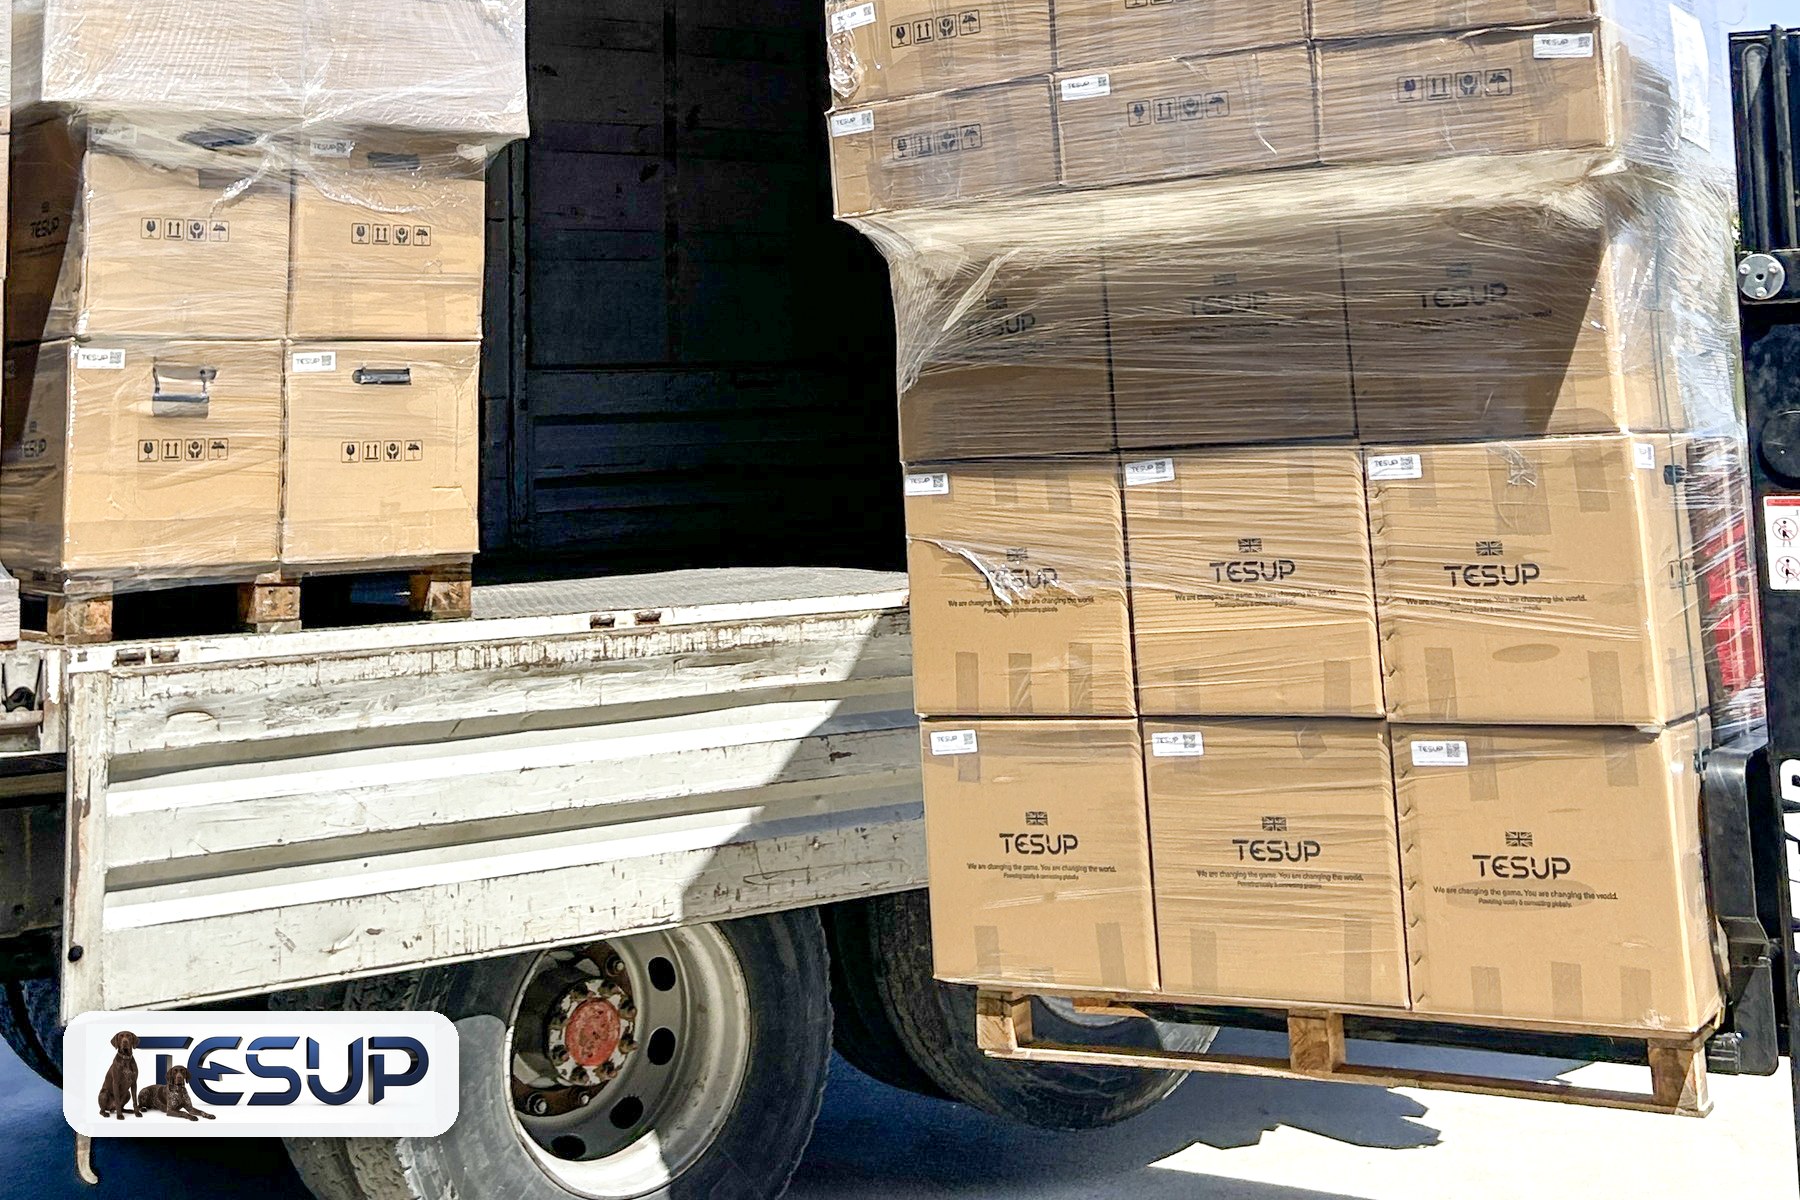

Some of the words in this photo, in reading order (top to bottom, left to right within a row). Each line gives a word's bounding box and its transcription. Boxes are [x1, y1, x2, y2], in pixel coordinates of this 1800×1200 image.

[81, 353, 109, 362] TESUP
[295, 357, 321, 366] TESUP
[1131, 464, 1154, 474] TESUP
[1373, 459, 1399, 468] TESUP
[909, 477, 931, 485] TESUP
[1209, 559, 1296, 583] TESUP
[1443, 563, 1540, 588] TESUP
[1406, 598, 1419, 606] We
[1521, 595, 1551, 604] changing
[936, 734, 958, 743] TESUP
[1155, 736, 1179, 745] TESUP
[1417, 745, 1444, 753] TESUP
[998, 832, 1078, 855] TESUP
[1232, 838, 1321, 863] TESUP
[966, 862, 977, 870] We
[987, 862, 1012, 871] changing
[1061, 864, 1087, 873] changing
[1472, 854, 1571, 880] TESUP
[1196, 869, 1208, 878] We
[1219, 869, 1247, 880] changing
[1248, 870, 1258, 878] the
[1279, 872, 1290, 880] You
[1302, 872, 1331, 882] changing
[1332, 873, 1343, 881] the
[1344, 873, 1364, 882] world.
[1433, 885, 1445, 894] We
[1446, 887, 1457, 895] are
[1457, 887, 1488, 896] changing
[1490, 888, 1501, 896] the
[1524, 889, 1537, 897] You
[1550, 890, 1582, 900] changing
[1583, 891, 1595, 900] the
